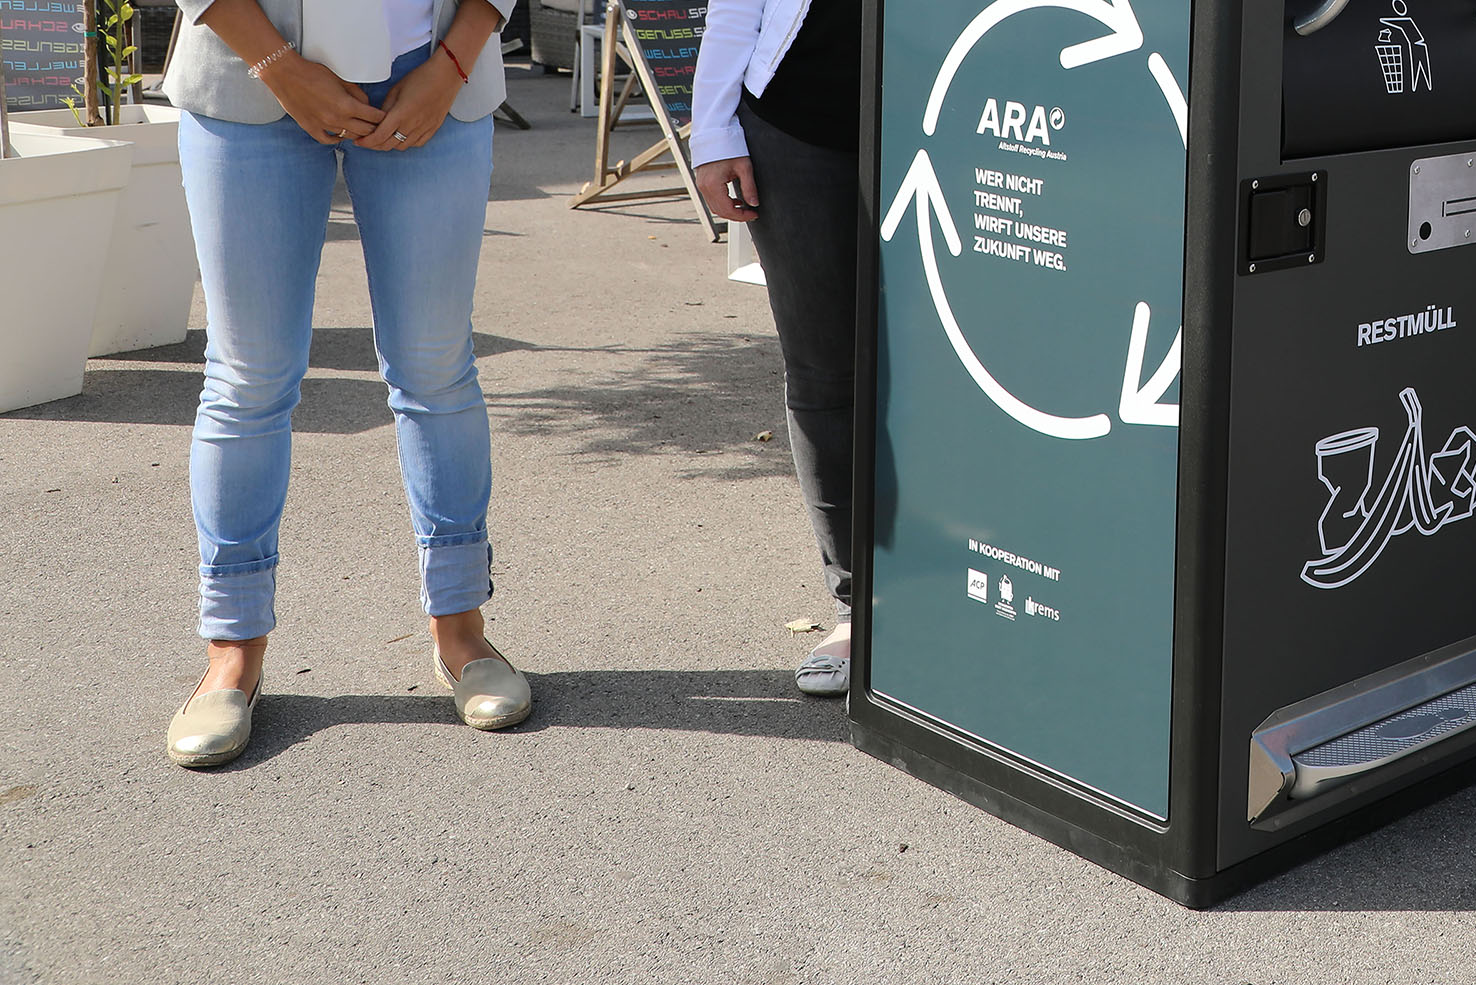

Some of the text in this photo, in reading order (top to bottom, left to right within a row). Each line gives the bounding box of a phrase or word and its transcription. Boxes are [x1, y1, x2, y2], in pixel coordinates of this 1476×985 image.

[976, 98, 1050, 146] ARA
[998, 141, 1067, 161] Altstoff Recycling Austria
[975, 167, 1044, 196] WER NICHT
[973, 190, 1024, 218] TRENNT,
[974, 213, 1067, 248] WIRFT UNSERE
[973, 235, 1067, 271] ZUKUNFT WEG.
[1357, 304, 1457, 347] RESTMÜLL
[968, 538, 1061, 582] IN KOOPERATION MIT
